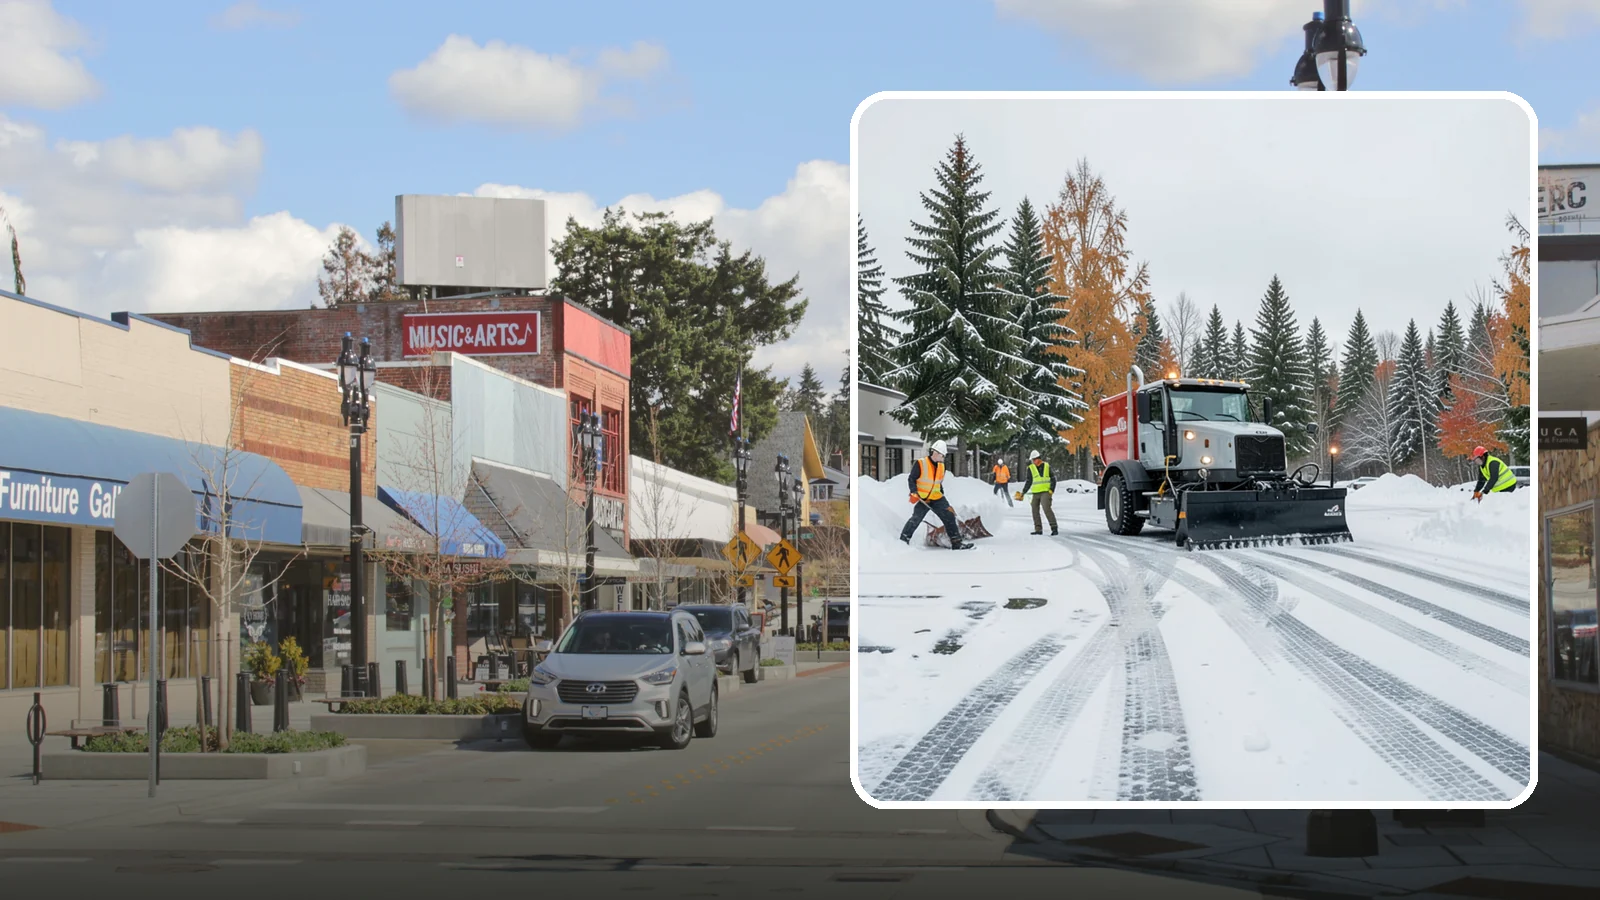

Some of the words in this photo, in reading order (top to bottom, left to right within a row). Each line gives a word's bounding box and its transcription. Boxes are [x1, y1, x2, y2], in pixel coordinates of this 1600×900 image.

[409, 323, 519, 348] MUSIC&ARTS
[1541, 428, 1577, 436] UGA
[90, 482, 122, 519] Gal
